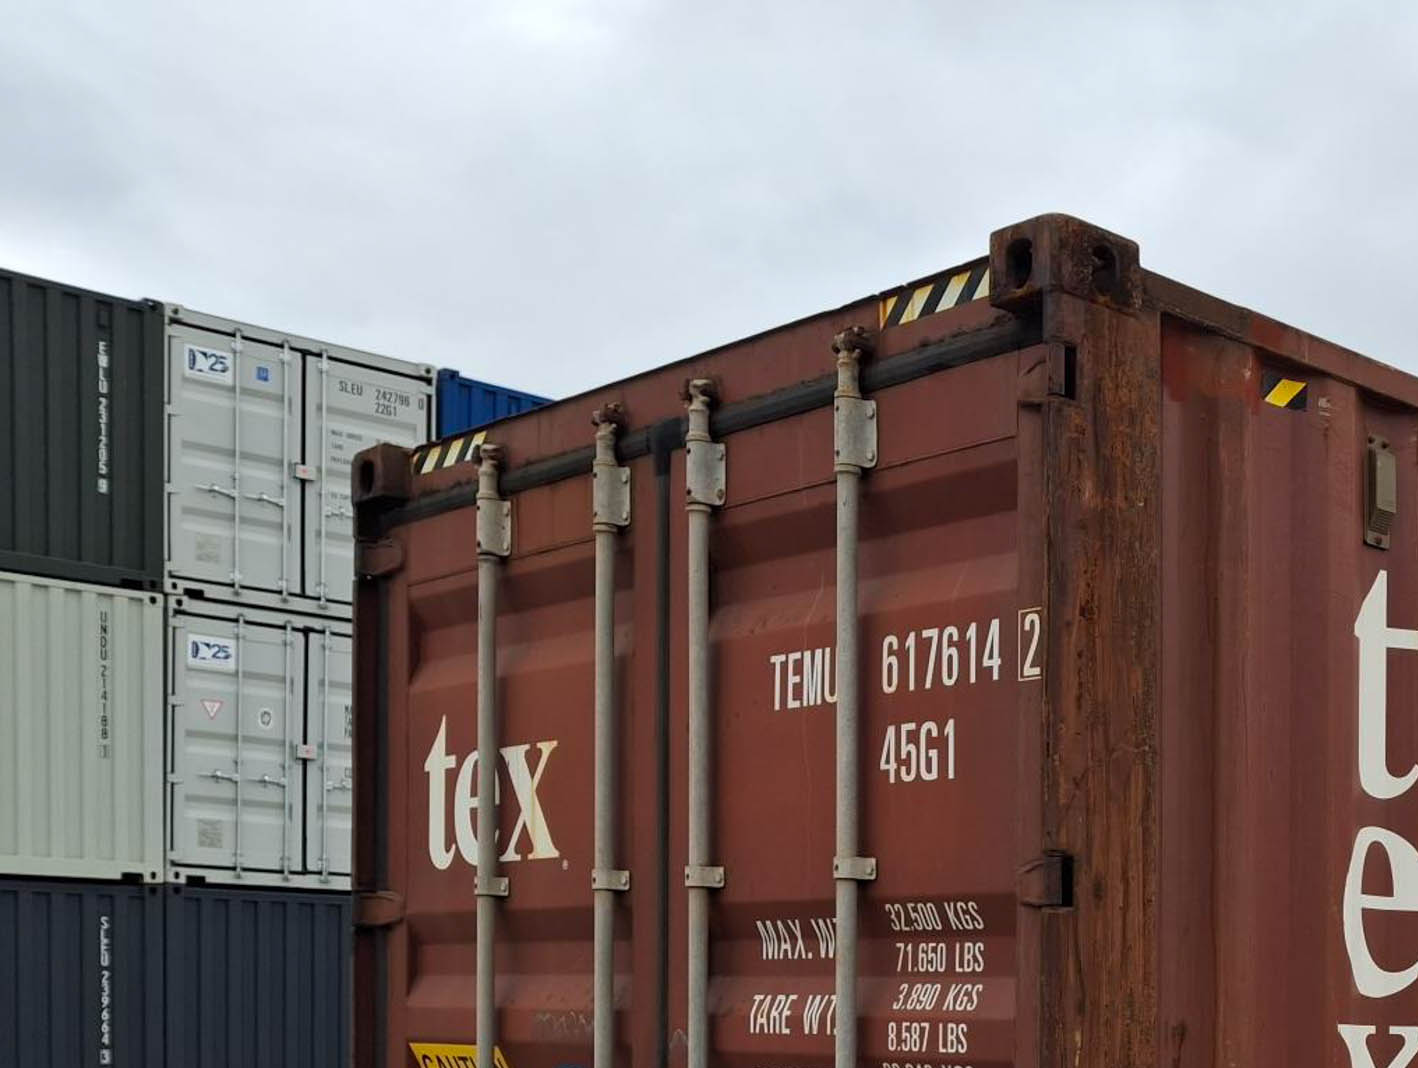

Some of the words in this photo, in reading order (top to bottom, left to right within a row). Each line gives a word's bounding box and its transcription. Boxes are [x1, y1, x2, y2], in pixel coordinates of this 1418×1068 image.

[339, 380, 363, 396] SLEU
[375, 403, 397, 417] 22G1
[770, 647, 837, 711] TEMU
[881, 618, 1001, 694] 617614
[1022, 612, 1041, 677] 2
[879, 718, 955, 784] 45G1
[424, 714, 560, 869] tex
[756, 919, 813, 960] MAX.
[811, 918, 836, 959] W
[885, 902, 942, 931] 32.500
[945, 901, 984, 930] KGS
[896, 942, 946, 972] 71.650
[955, 942, 984, 973] LBS
[750, 994, 798, 1035] TARE
[892, 983, 940, 1010] 3.890
[943, 983, 983, 1011] KGS
[888, 1021, 930, 1052] 8.587
[938, 1023, 967, 1054] LBS
